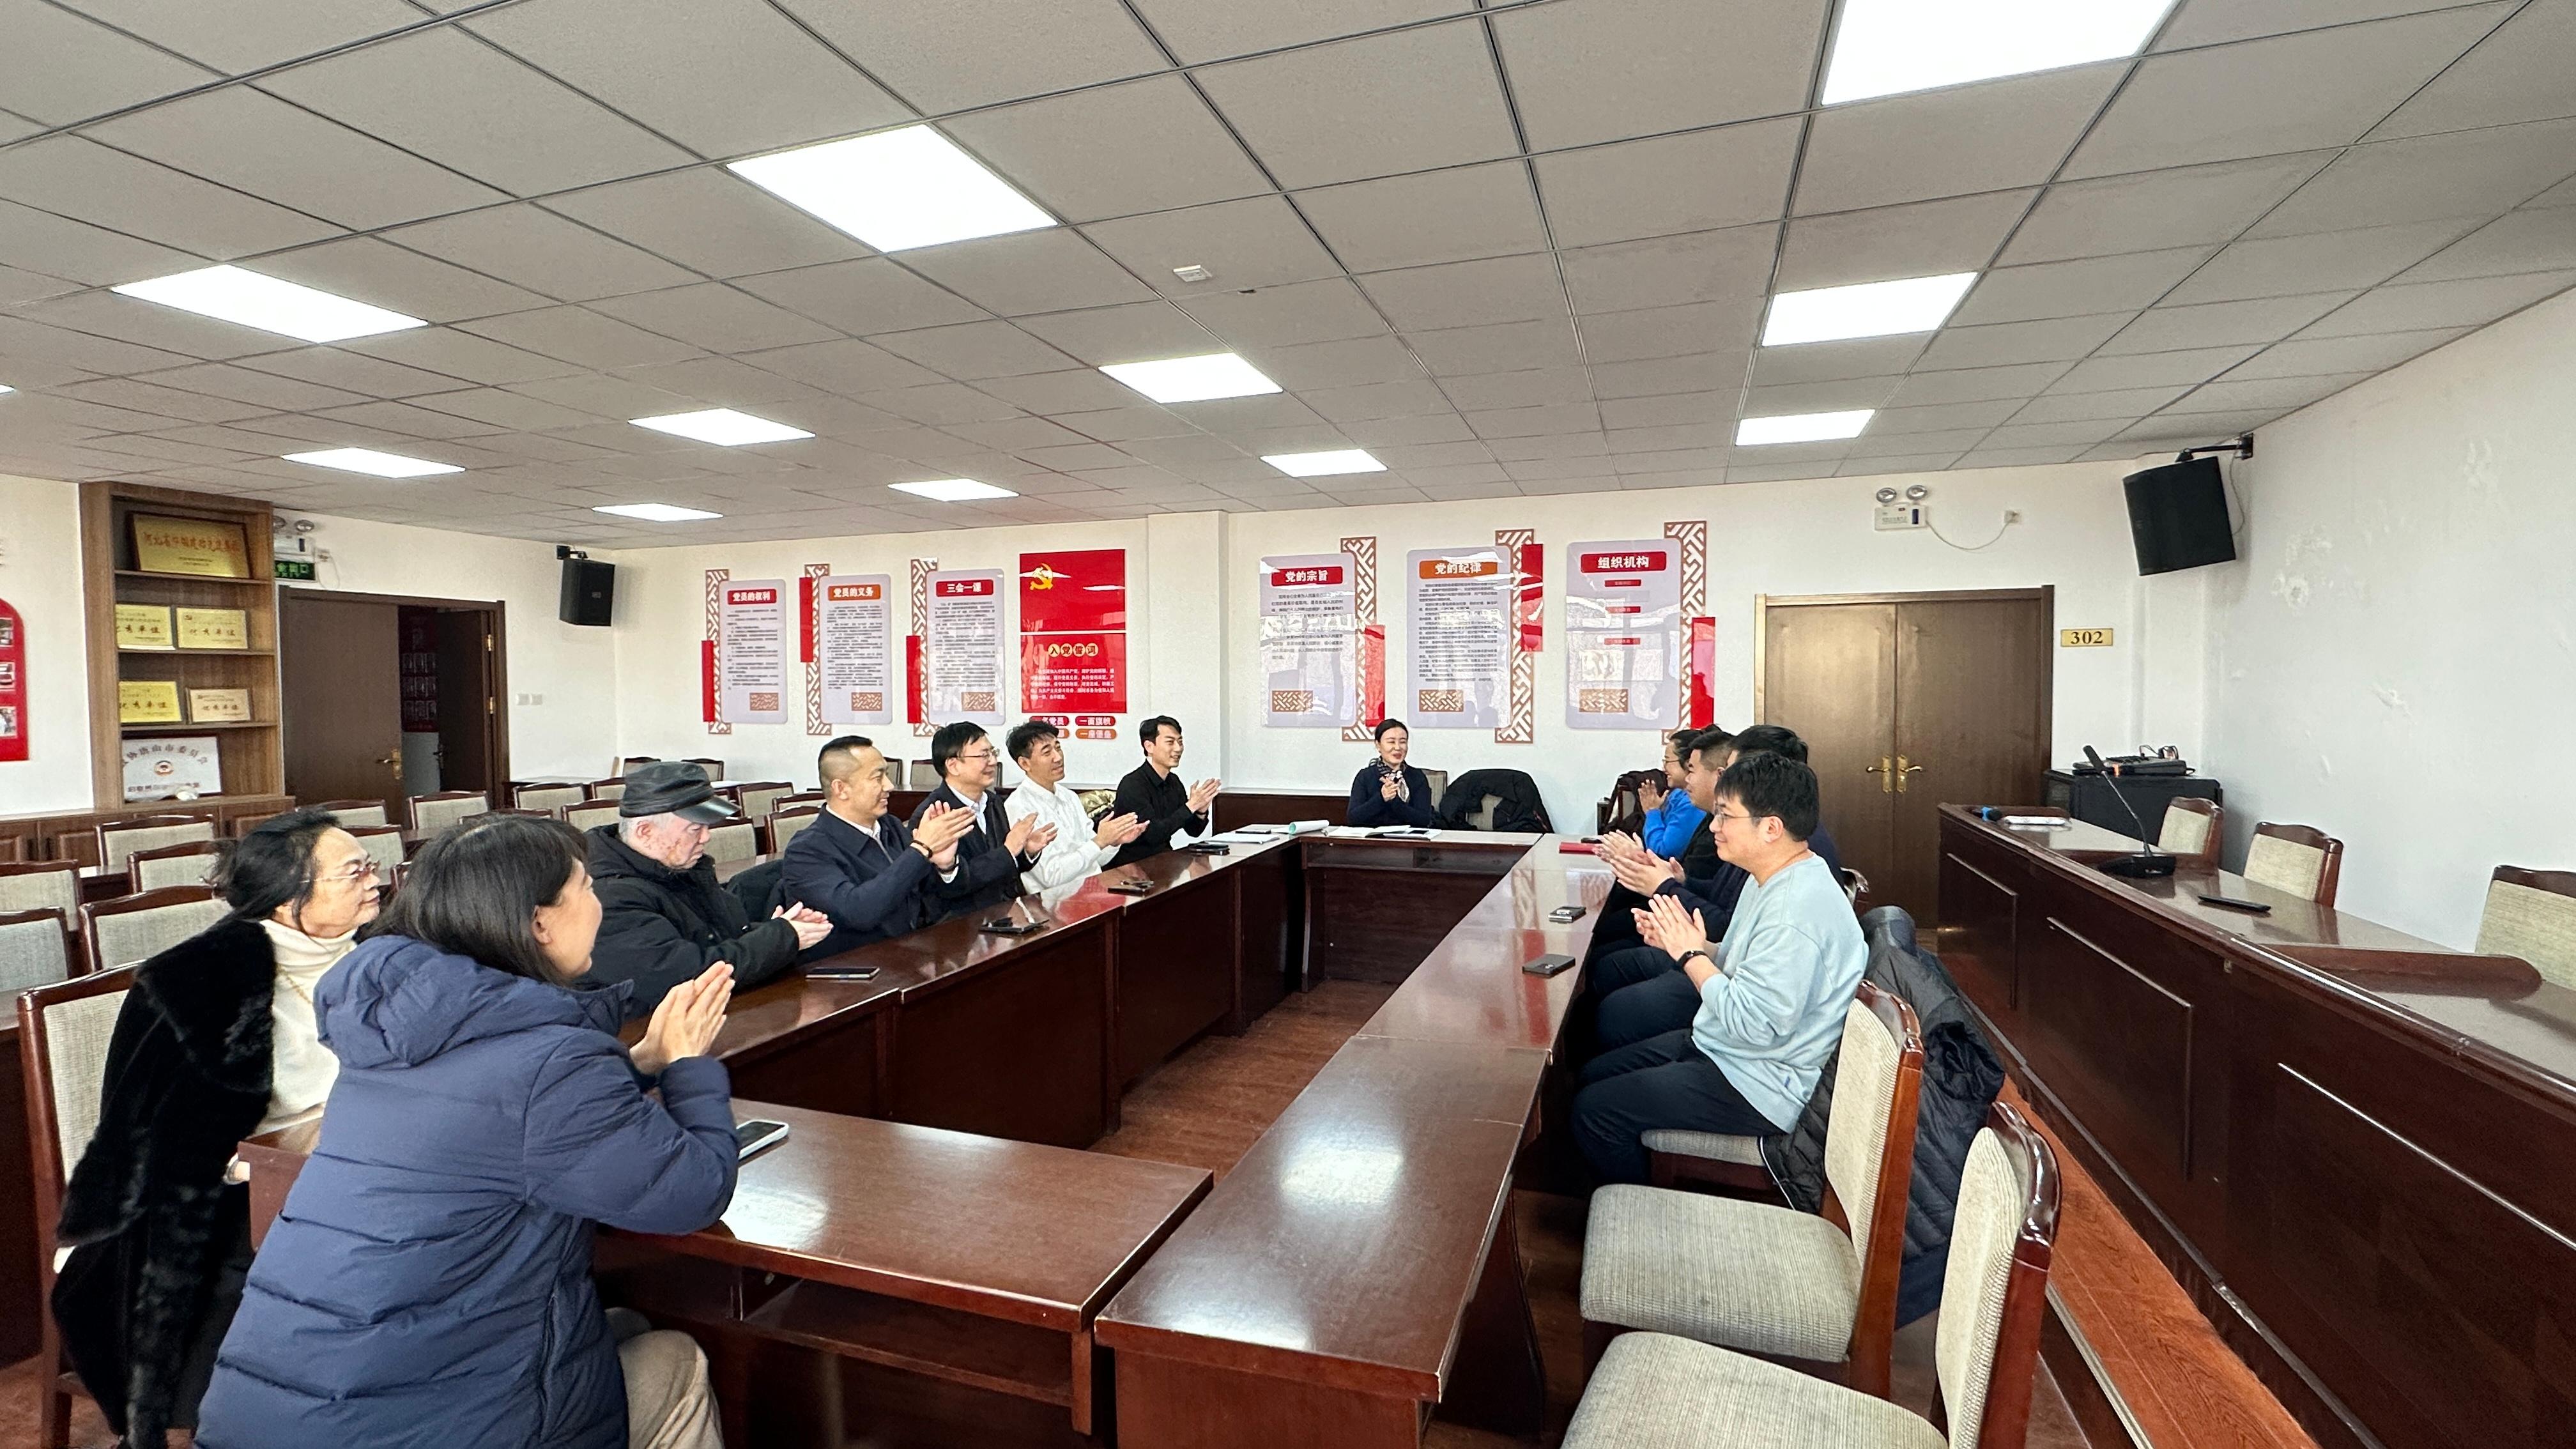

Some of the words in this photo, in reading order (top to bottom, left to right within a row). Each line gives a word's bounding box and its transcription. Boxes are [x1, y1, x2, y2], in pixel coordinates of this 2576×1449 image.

[1597, 555, 1650, 569] 组织机构
[1435, 562, 1482, 575] 党的纪律
[1285, 570, 1328, 583] 党的宗旨
[833, 586, 874, 598] 党员的义务
[946, 582, 982, 593] 三会一课
[732, 591, 770, 602] 党员的权利
[2071, 631, 2103, 644] 302
[1050, 645, 1096, 656] 入党誓词
[1079, 716, 1112, 726] 一面旗帜
